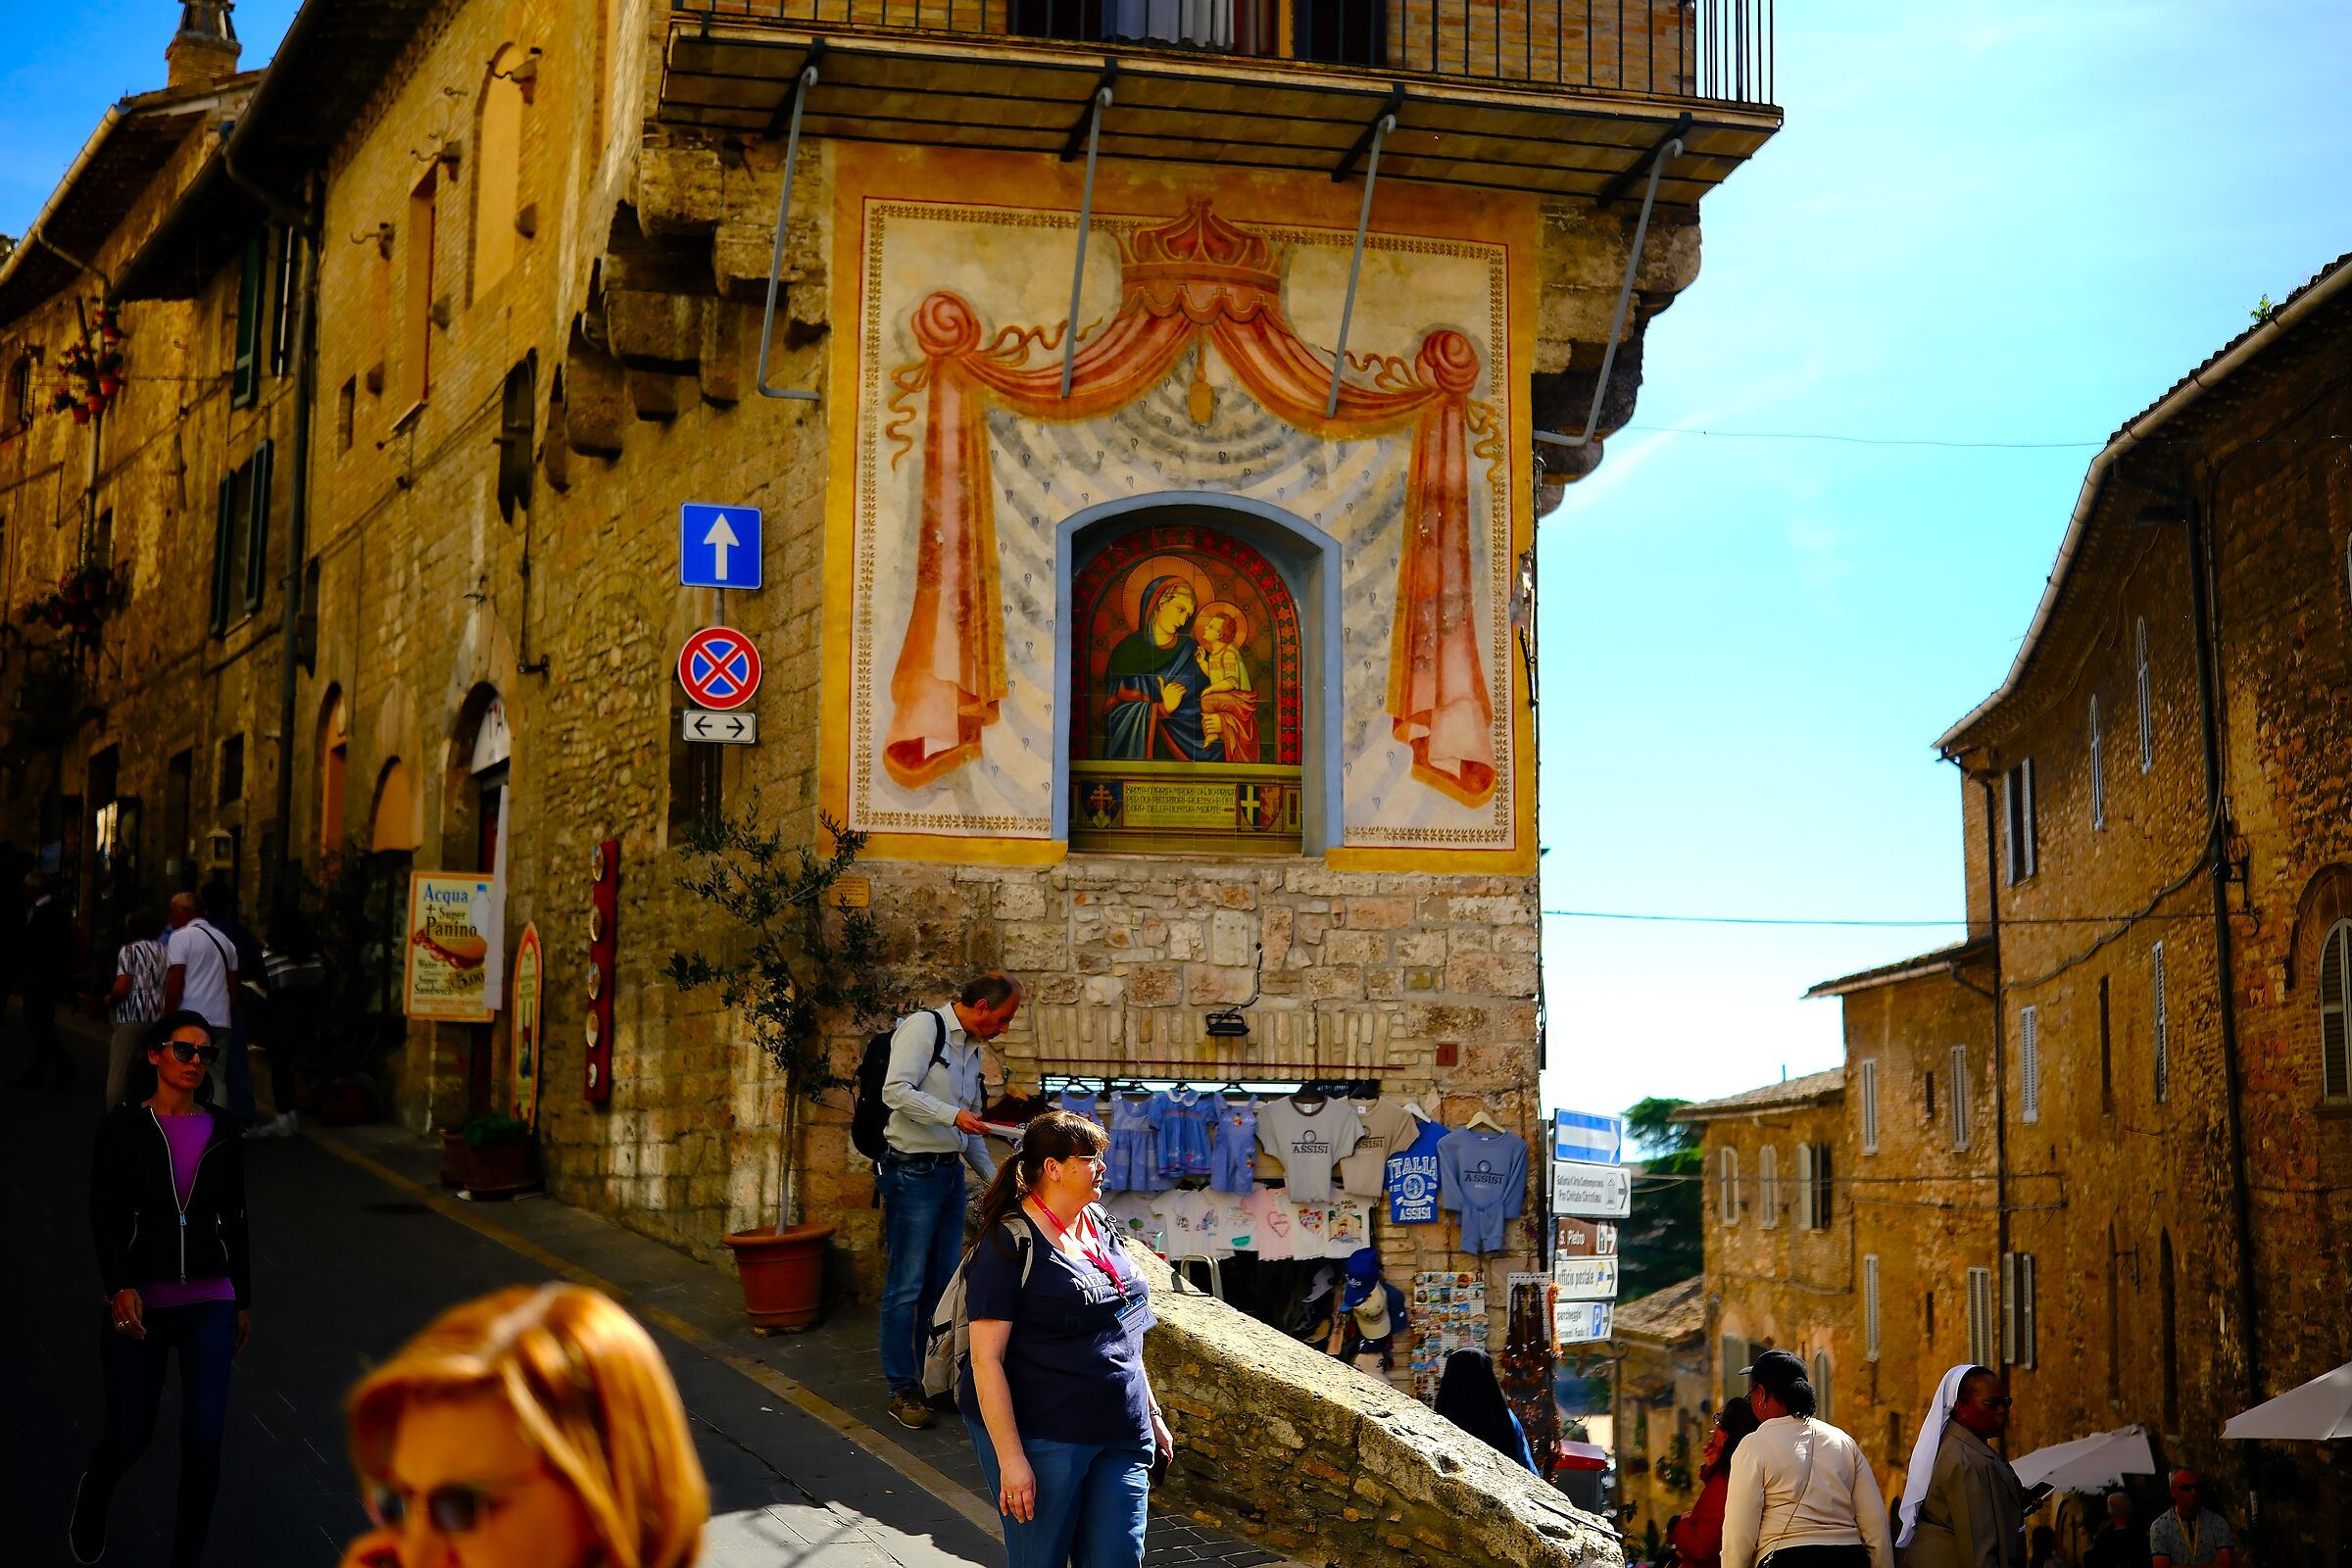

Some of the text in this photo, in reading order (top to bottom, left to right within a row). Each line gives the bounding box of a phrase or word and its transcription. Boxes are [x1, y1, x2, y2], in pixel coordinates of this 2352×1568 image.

[424, 884, 468, 906] Acqua
[439, 907, 466, 920] Super
[426, 916, 477, 938] Panino
[1293, 1145, 1328, 1153] ASSISI
[1387, 1155, 1438, 1183] ITALIA
[1464, 1174, 1503, 1185] ASSISI
[1399, 1206, 1431, 1220] ASSISI
[1558, 1229, 1586, 1246] S. Pietro
